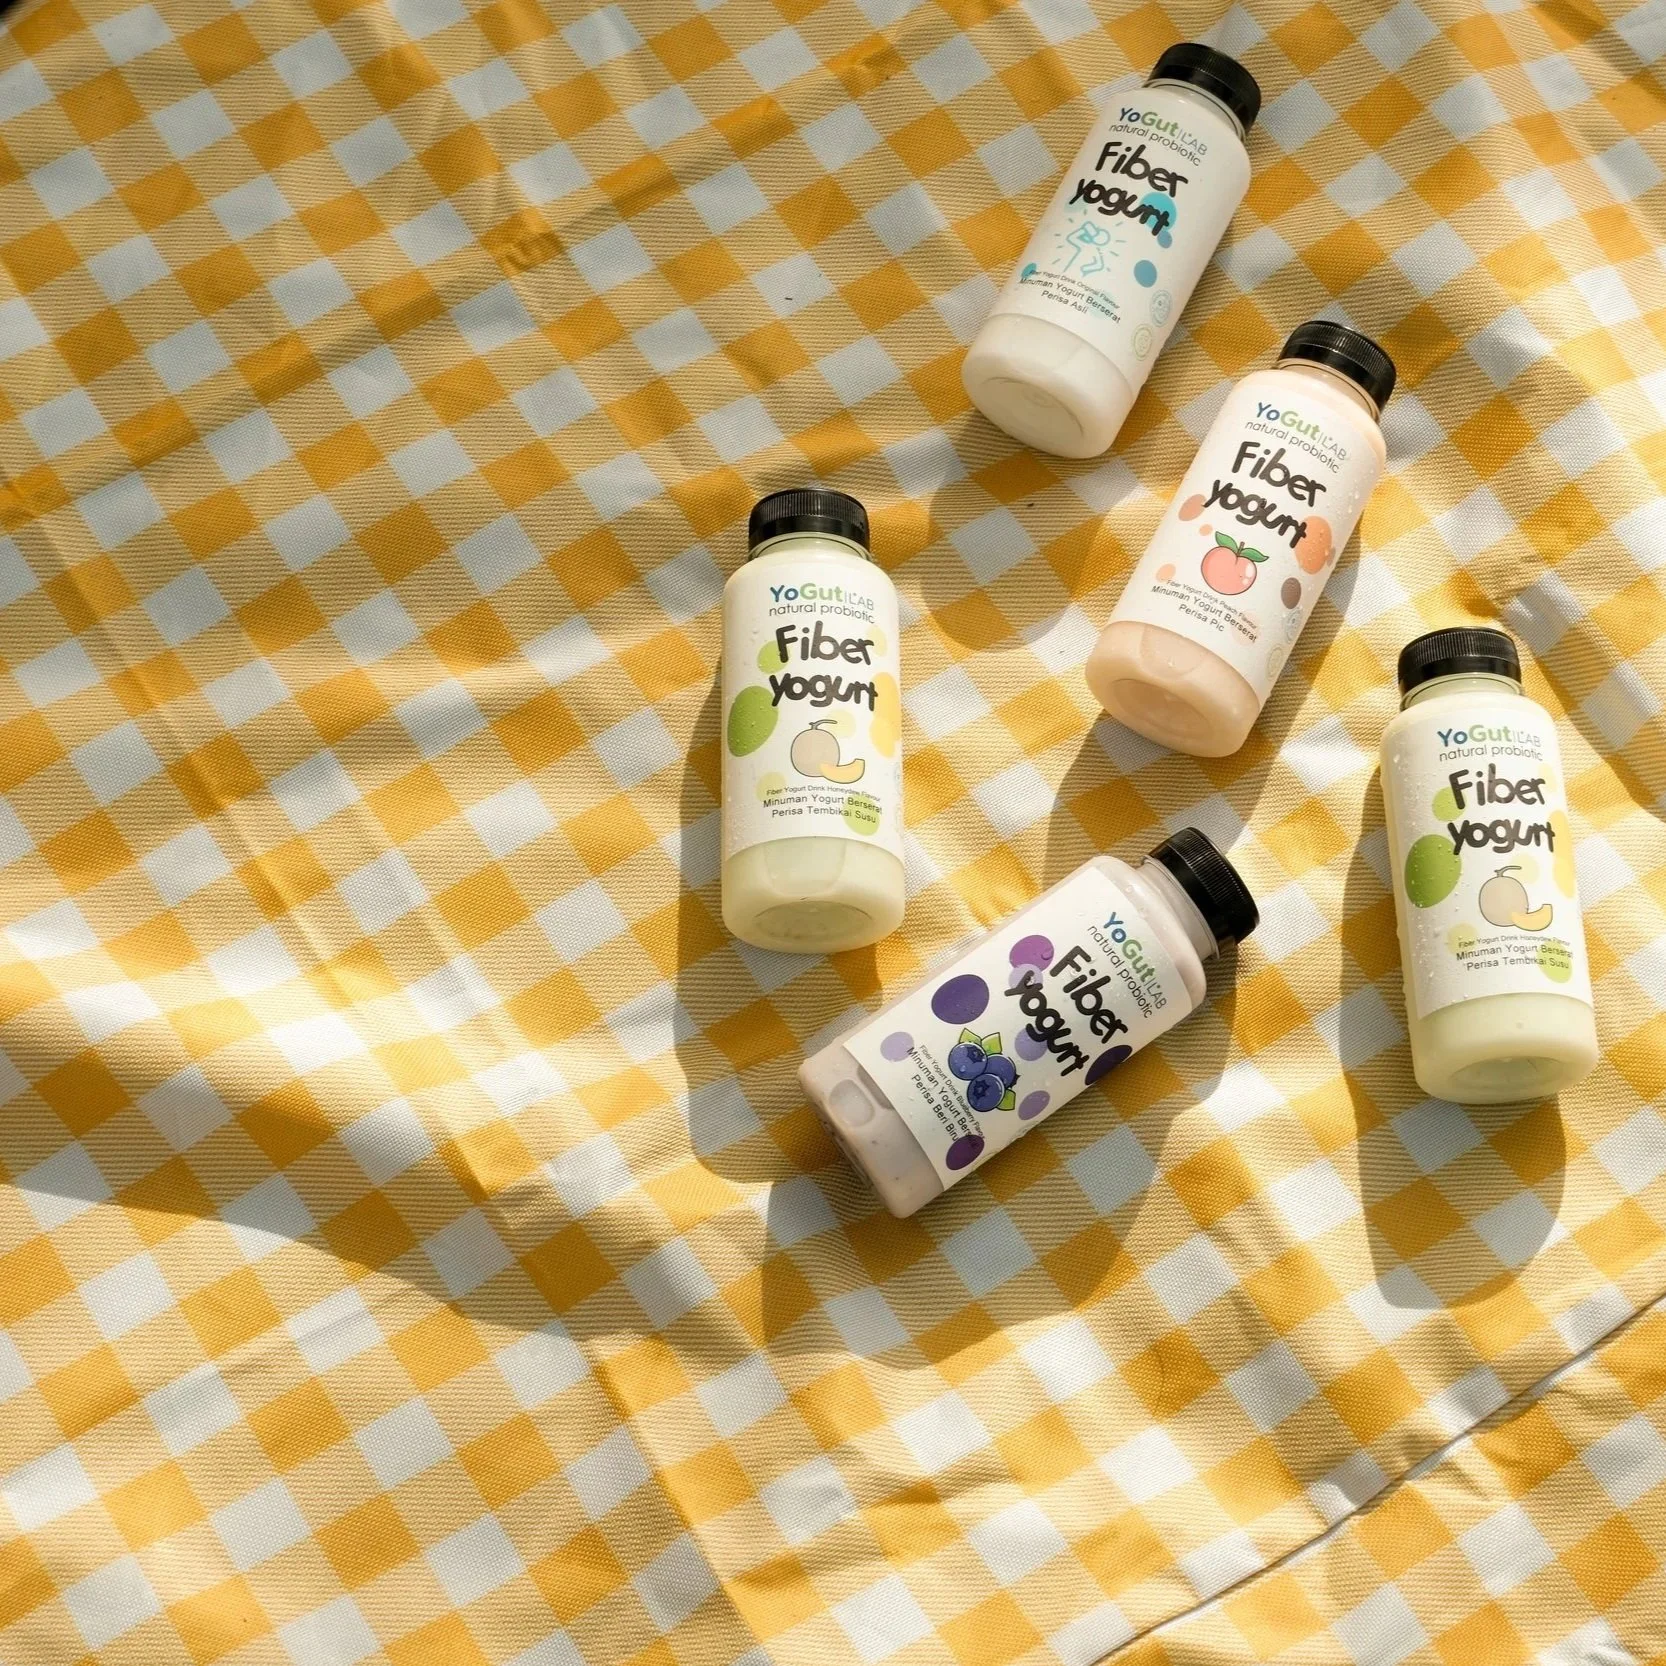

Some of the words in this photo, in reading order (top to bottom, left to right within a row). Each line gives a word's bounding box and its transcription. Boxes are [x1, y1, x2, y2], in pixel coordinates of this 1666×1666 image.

[1109, 123, 1149, 137] natural
[1149, 132, 1201, 166] probiotic
[1095, 141, 1189, 198] Fiber
[1069, 179, 1170, 236] yogurt
[1041, 290, 1070, 305] Perisa
[1070, 301, 1089, 315] Asli
[1056, 283, 1085, 300] Yogurt
[1085, 296, 1121, 324] Berserat
[1245, 421, 1290, 440] natural
[1288, 436, 1340, 474] probiotic
[1231, 441, 1327, 508] Fiber
[1202, 479, 1308, 549] yogurt
[769, 602, 817, 616] natural
[820, 605, 876, 624] probiotic
[1151, 585, 1190, 601] Minuman
[1193, 596, 1223, 617] Yogurt
[1224, 613, 1258, 643] Berserat
[1179, 604, 1208, 622] Perisa
[1210, 618, 1226, 632] Pic
[775, 620, 875, 665] Fiber
[769, 672, 879, 712] yogurt
[1439, 744, 1487, 762] natural
[1491, 745, 1544, 761] probiotic
[763, 796, 808, 808] Minuman
[811, 794, 846, 805] Yogurt
[847, 797, 882, 815] Berserat
[1448, 763, 1546, 810] Fiber
[771, 807, 803, 818] Perisa
[806, 805, 852, 817] Tembikai
[855, 811, 877, 824] Susu
[1447, 819, 1555, 856] yogurt
[1087, 925, 1125, 968] natural
[1116, 968, 1153, 1019] probiotic
[1456, 946, 1502, 961] Minuman
[1505, 943, 1538, 954] Yogurt
[1466, 958, 1499, 971] Perisa
[1549, 957, 1570, 969] Susu
[1049, 945, 1128, 1044] Fiber
[1003, 969, 1090, 1077] yogurt
[906, 1047, 939, 1087] Minuman
[938, 1086, 961, 1118] Yogurt
[911, 1074, 935, 1105] Perisa
[932, 1103, 949, 1125] Beri
